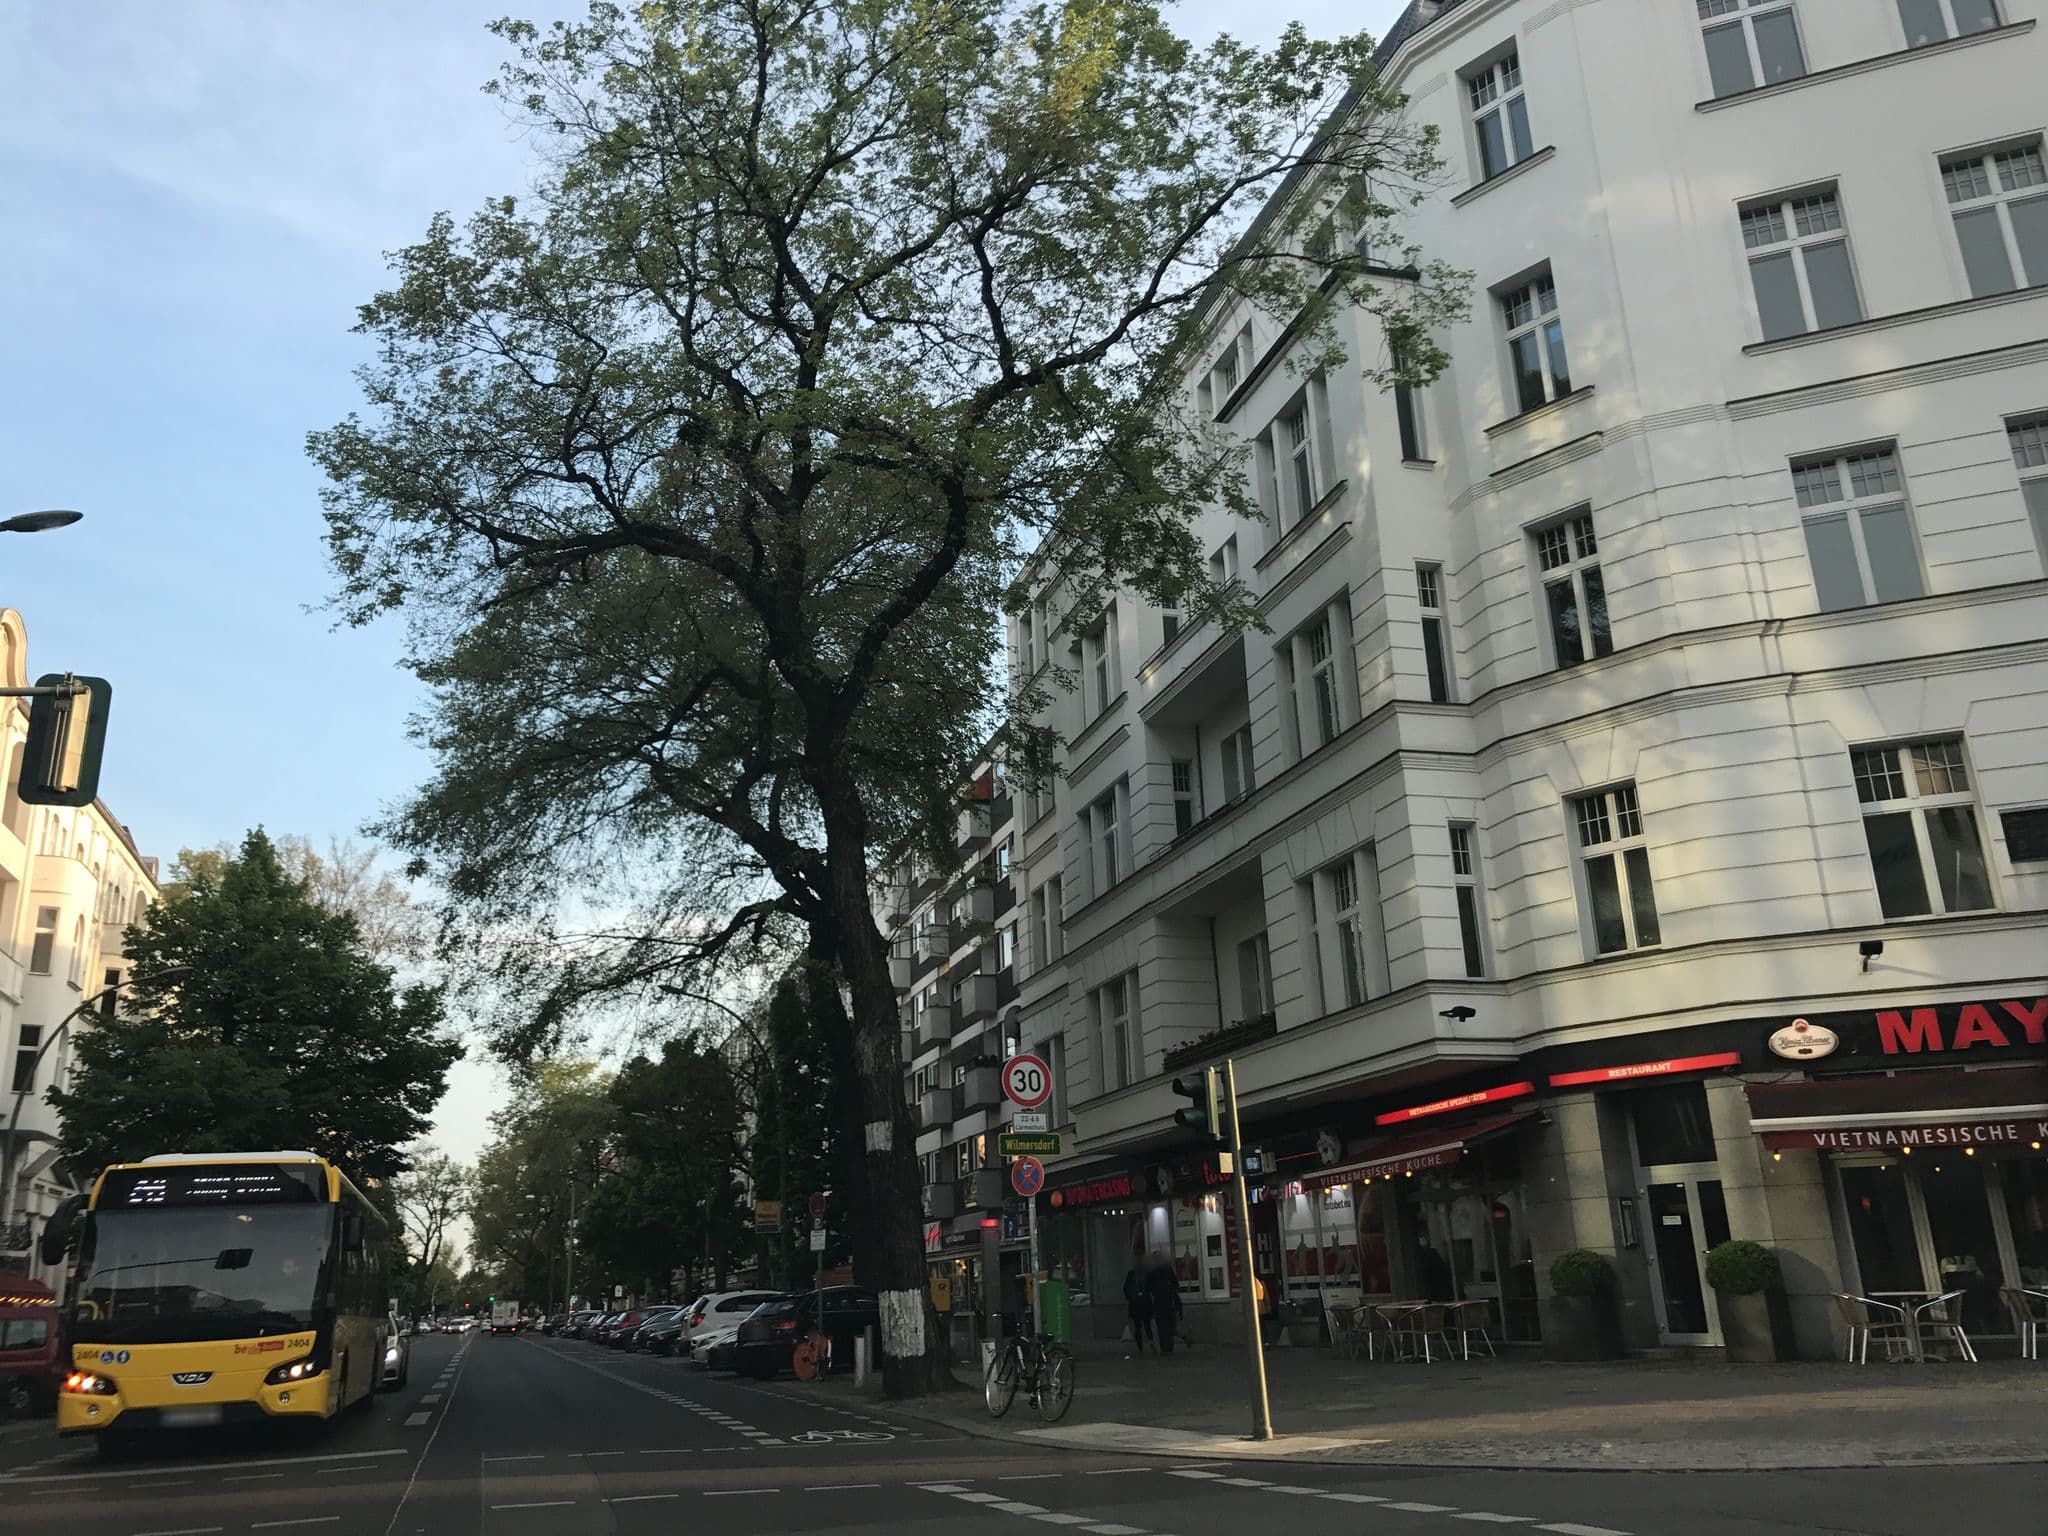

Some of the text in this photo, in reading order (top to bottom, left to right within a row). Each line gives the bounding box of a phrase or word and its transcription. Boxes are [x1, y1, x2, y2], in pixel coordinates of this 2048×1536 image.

[1876, 998, 2048, 1054] MAY
[1013, 1069, 1041, 1092] 30
[1608, 1062, 1672, 1078] RESTAURANT
[1006, 1138, 1054, 1151] Wilmersdorf
[1813, 1124, 2018, 1146] VIETNAMESISCHE
[1320, 1154, 1442, 1186] VIETNAMESISCHE KÜCHE
[288, 1338, 310, 1348] 2404
